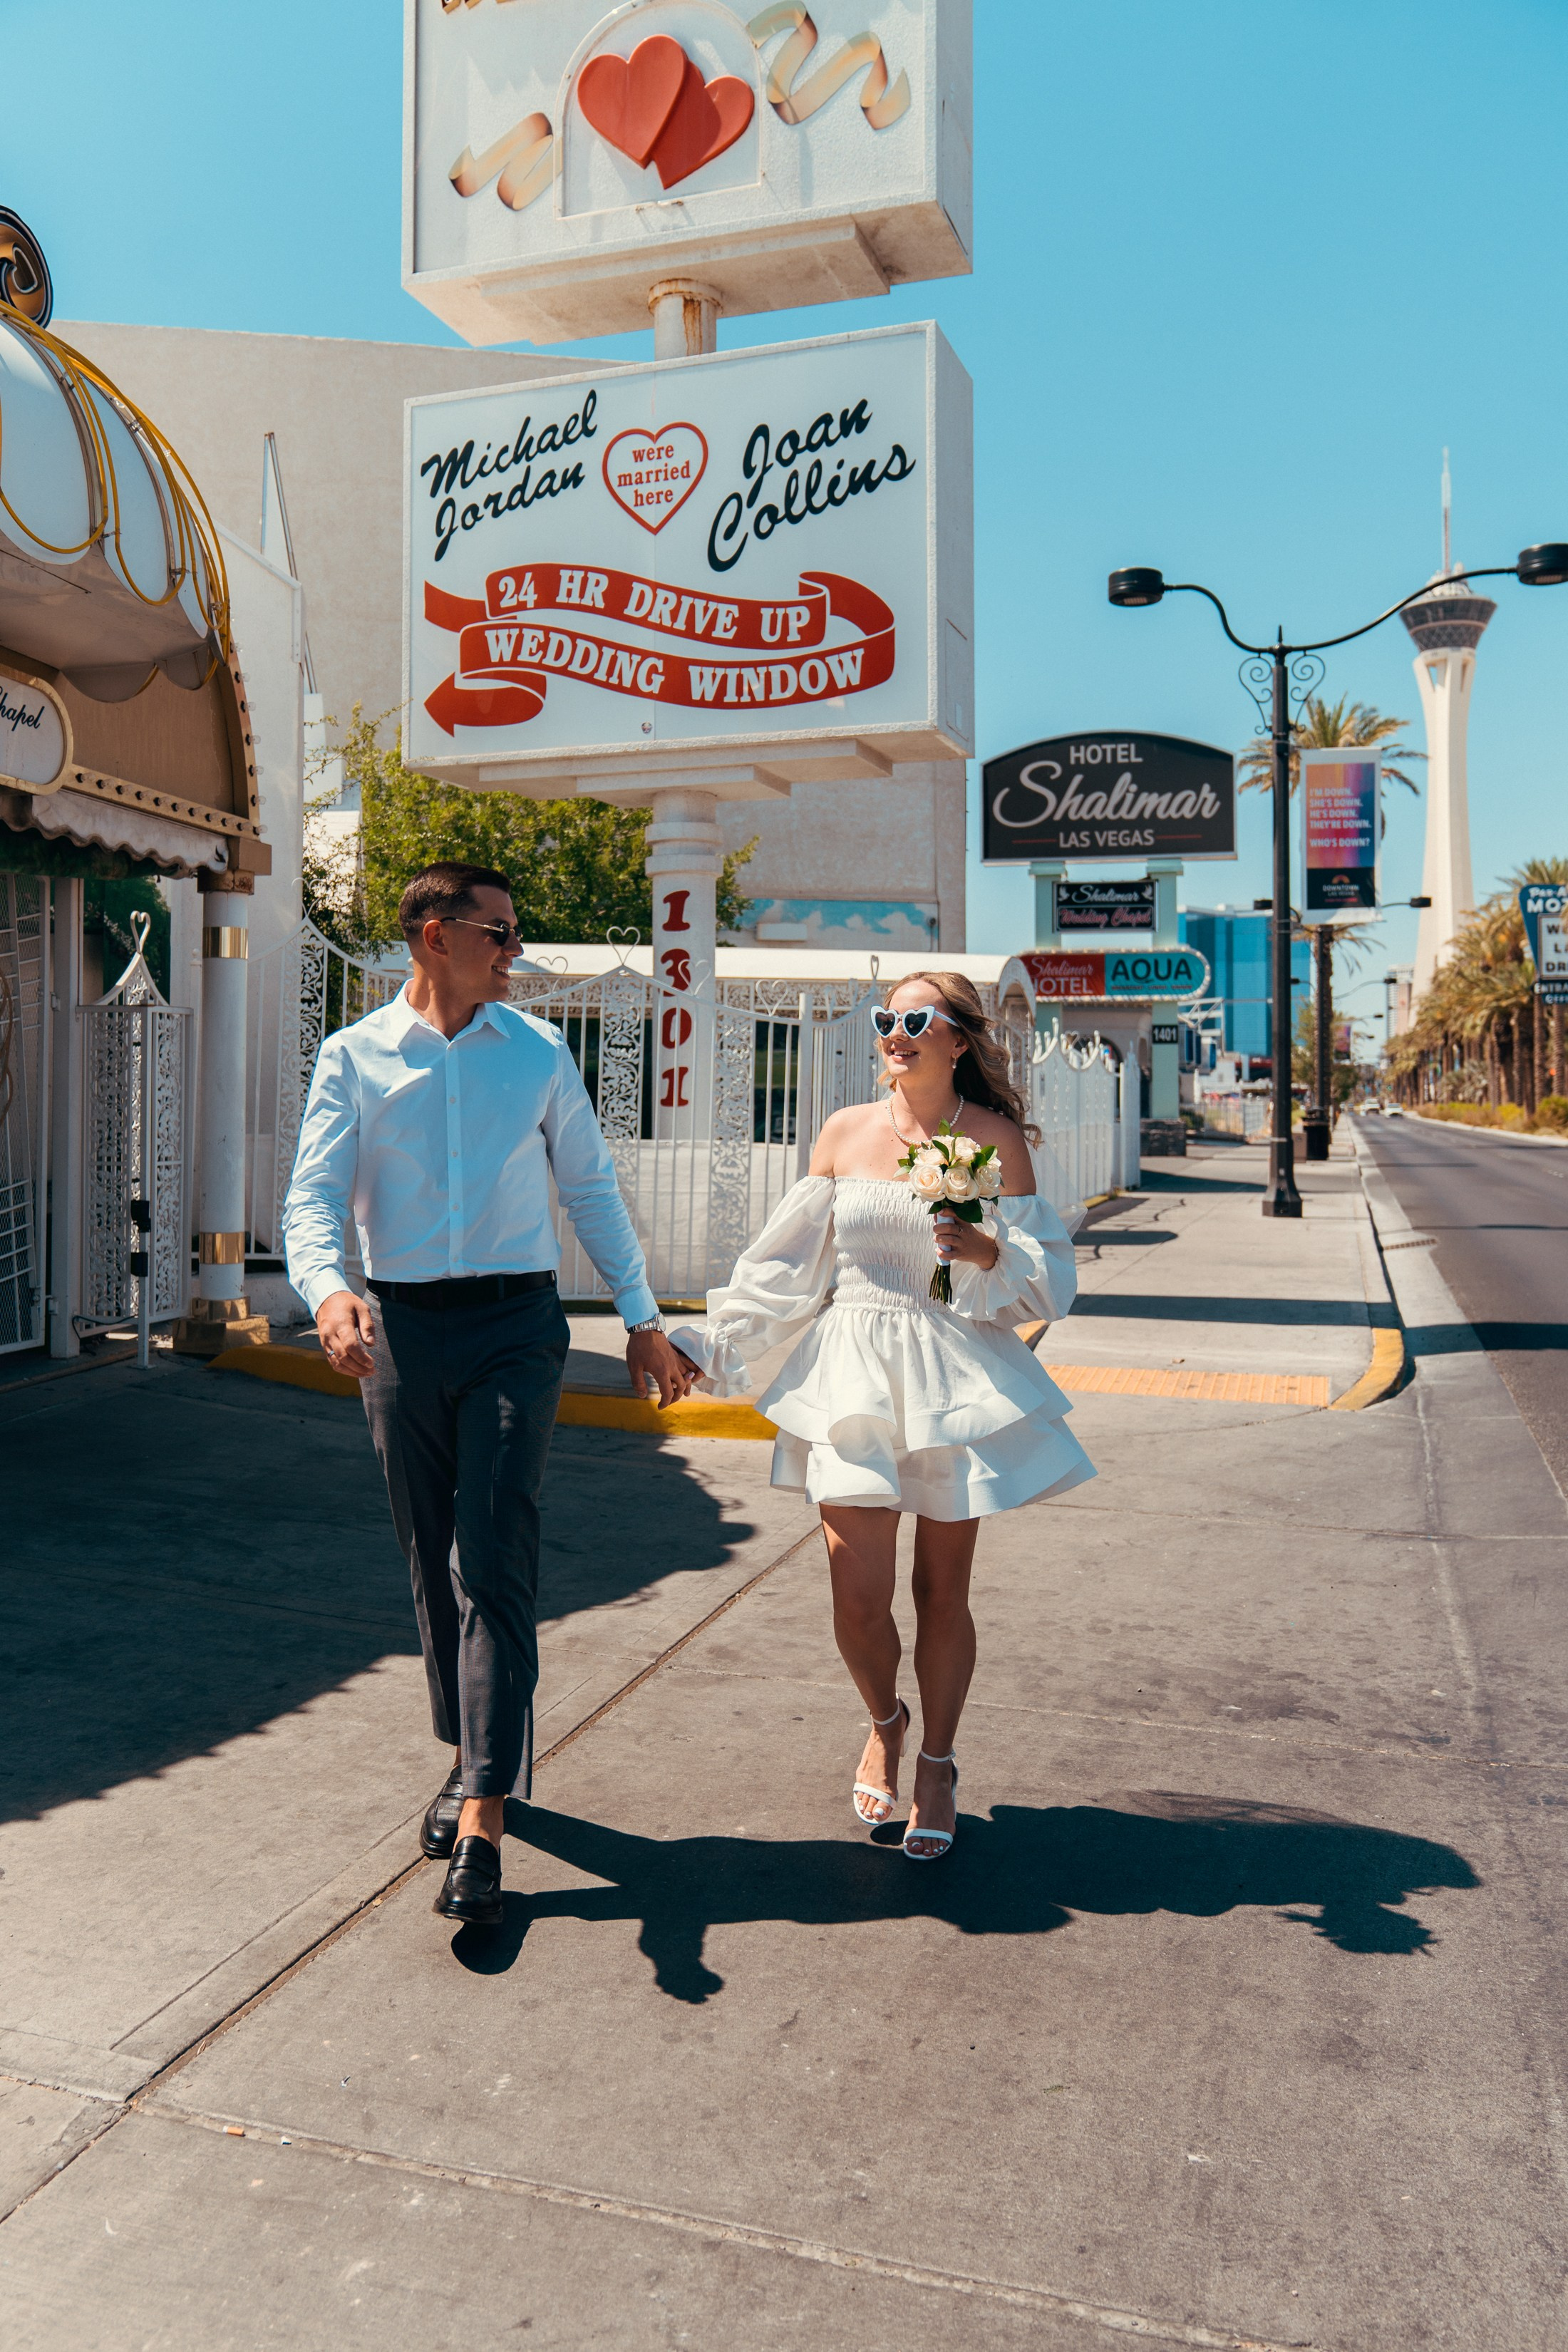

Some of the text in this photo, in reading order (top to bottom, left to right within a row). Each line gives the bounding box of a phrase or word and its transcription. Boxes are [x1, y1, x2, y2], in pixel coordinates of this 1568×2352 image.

[421, 389, 597, 498] Michael
[632, 445, 674, 463] were
[743, 398, 872, 509] Joan
[617, 460, 691, 487] married
[634, 488, 674, 507] here
[707, 443, 916, 572] Collins
[434, 462, 585, 562] Jordan
[499, 569, 810, 643] 24 HR DRIVE UP
[484, 628, 865, 703] WEDDING WINDOW
[0, 686, 45, 731] hapel
[1070, 744, 1143, 765] HOTEL
[993, 760, 1220, 827] Shalimar
[1310, 788, 1353, 796] I'M DOWN.
[1310, 798, 1364, 808] SHE'S DOWN.
[1310, 809, 1358, 818] HE'S DOWN.
[1310, 820, 1372, 829] THEY'RE DOWN.
[1059, 830, 1155, 848] LAS VEGAS
[1310, 837, 1371, 847] WHO'S DOWN?
[1071, 884, 1140, 903] Shalimar
[1060, 907, 1152, 928] Wedding Chapel
[1031, 956, 1094, 976] Shalimar
[1111, 958, 1192, 983] AQUA
[660, 889, 692, 1108] 1301
[1153, 1026, 1177, 1041] 1401
